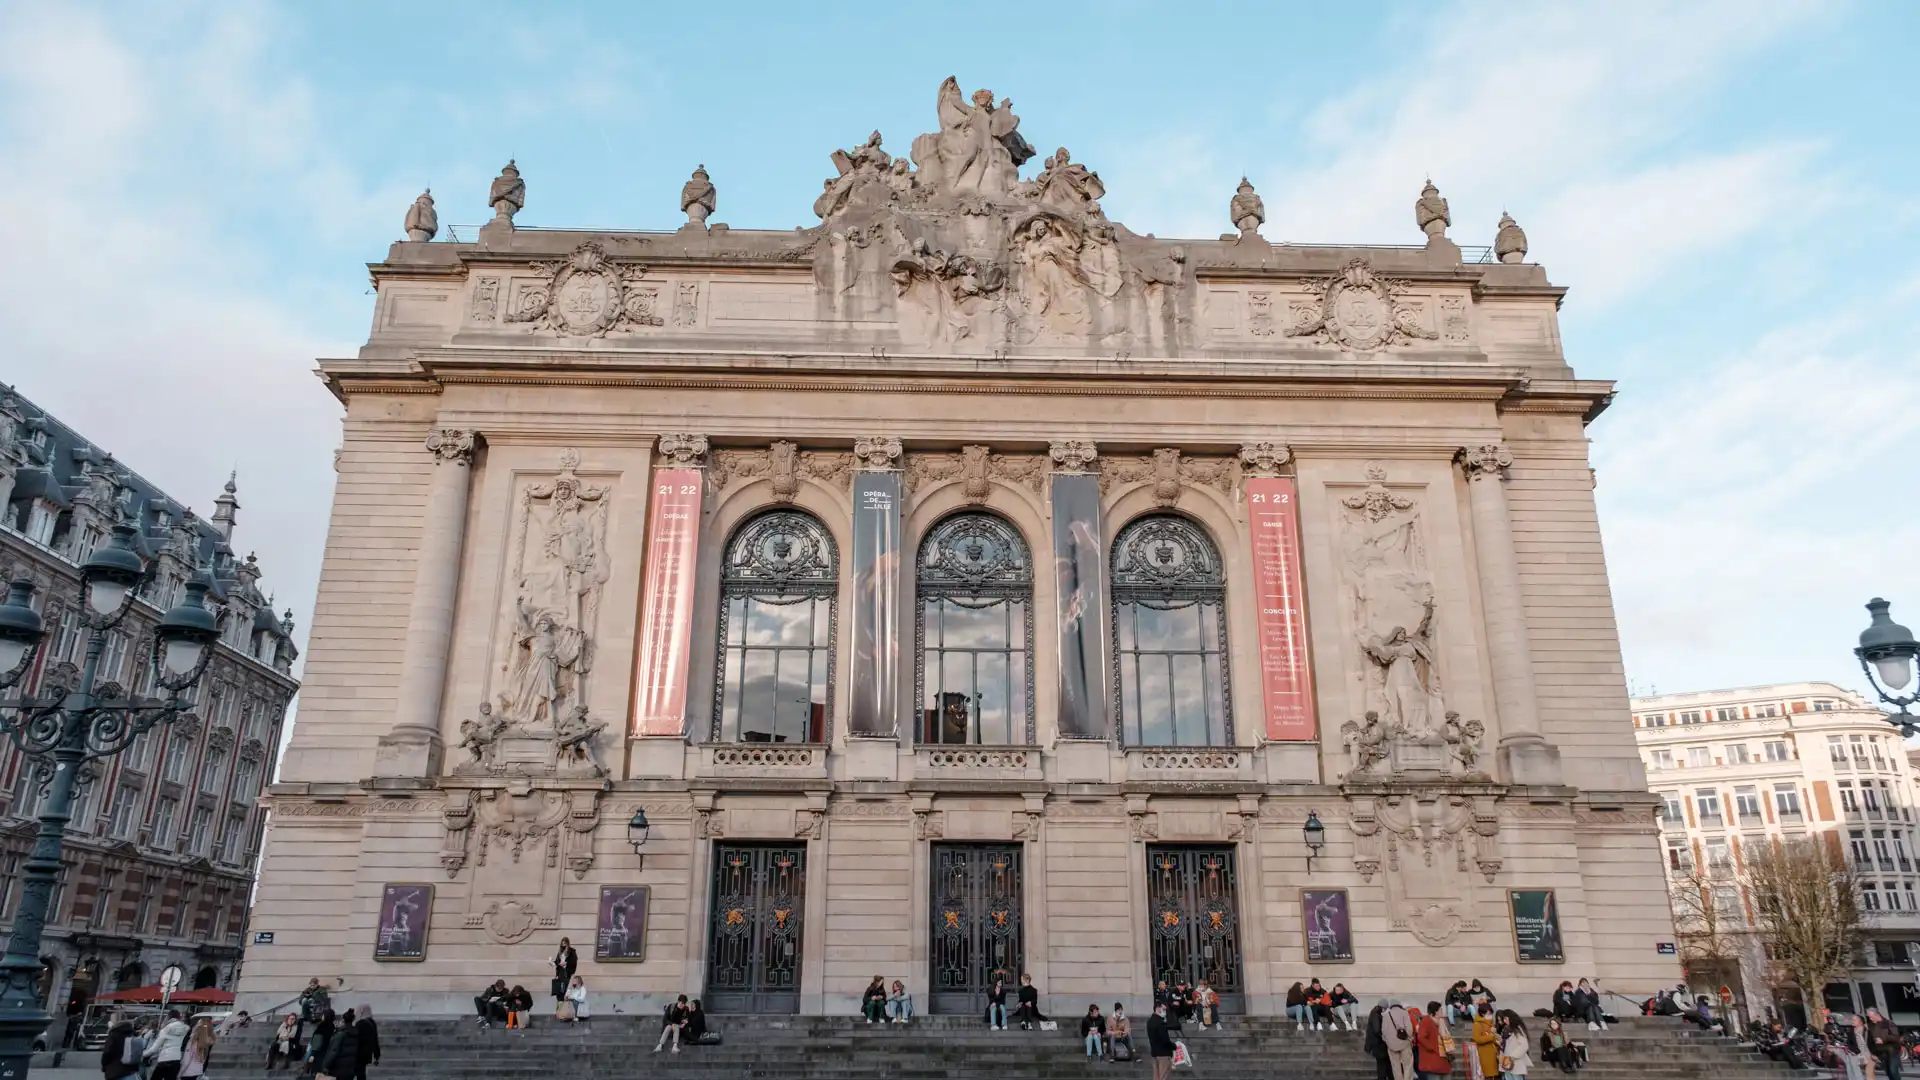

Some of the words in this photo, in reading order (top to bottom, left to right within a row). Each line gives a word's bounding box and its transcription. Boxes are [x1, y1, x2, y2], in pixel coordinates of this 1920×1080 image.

[659, 485, 673, 495] 21
[680, 485, 697, 495] 22
[863, 490, 887, 498] OPÉRA
[1252, 493, 1266, 503] 21
[1273, 494, 1289, 504] 22
